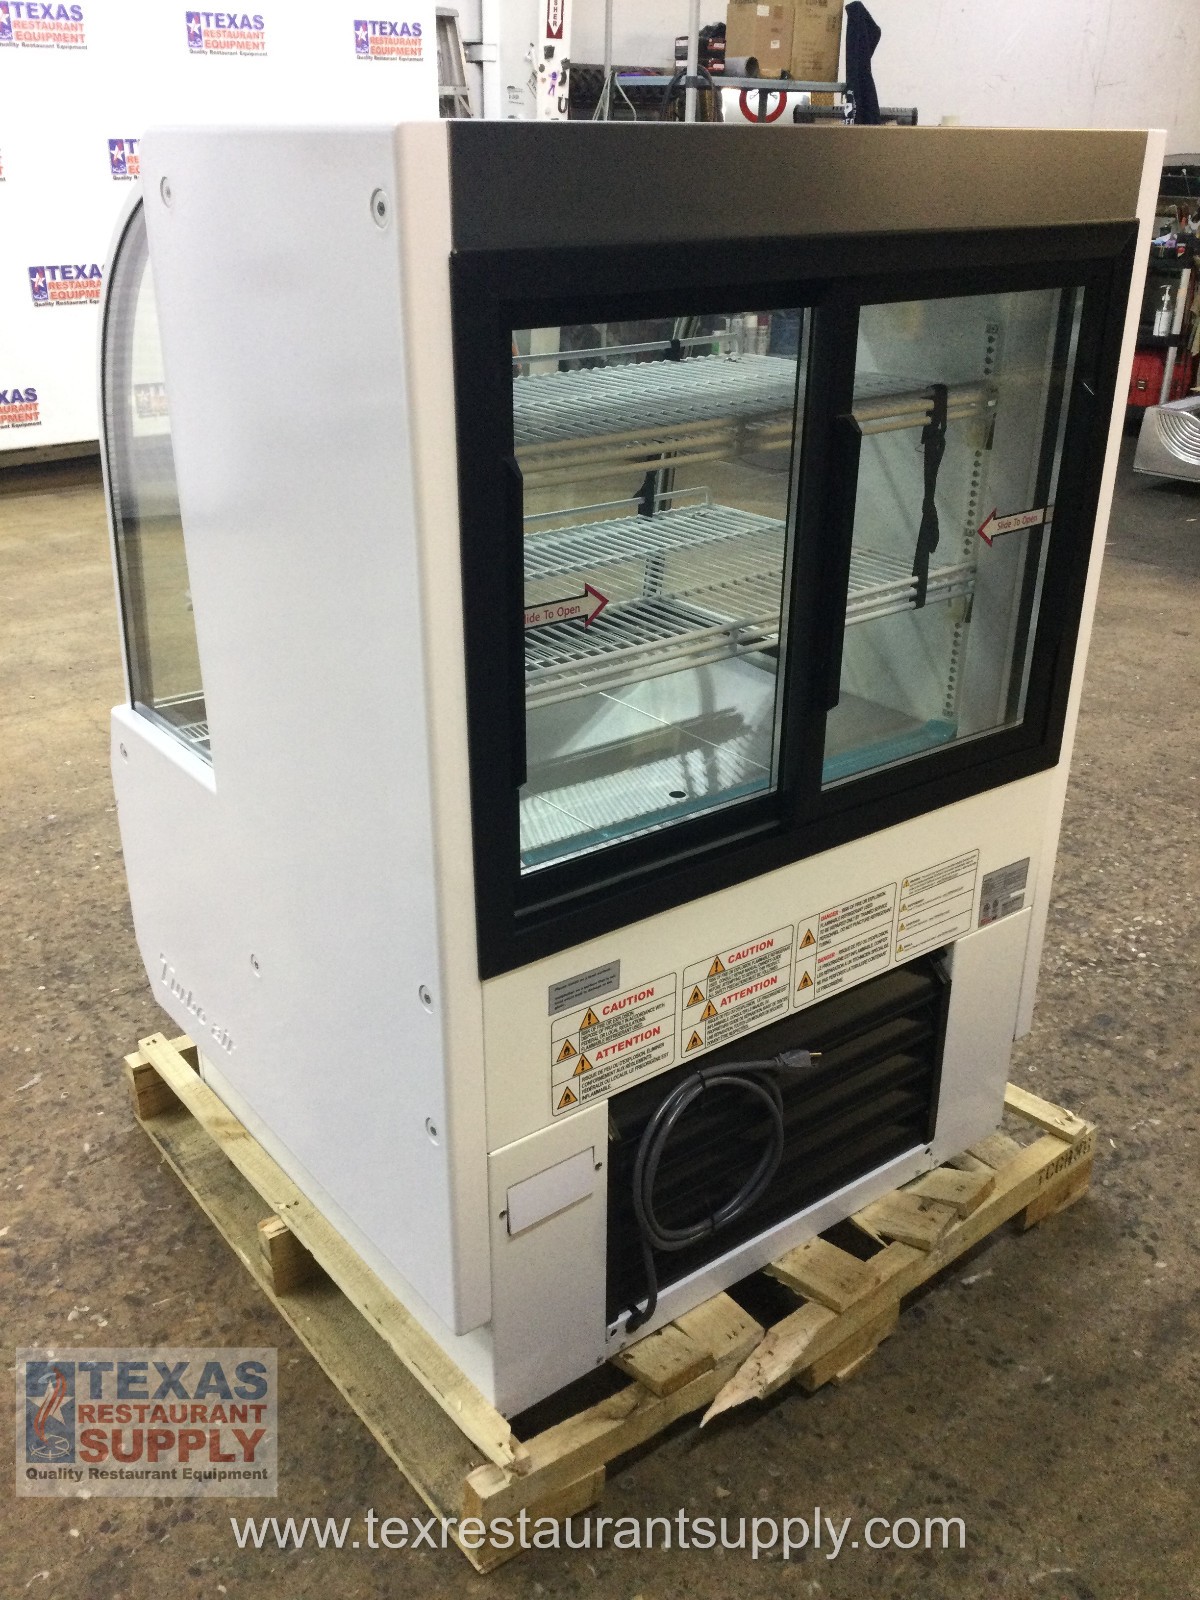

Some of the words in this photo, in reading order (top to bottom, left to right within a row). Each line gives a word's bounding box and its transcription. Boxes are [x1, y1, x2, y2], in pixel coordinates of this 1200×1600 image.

[10, 1, 83, 21] TEXAS
[13, 20, 84, 32] RESTAURANT
[202, 12, 264, 30] TEXAS
[369, 20, 422, 37] TEXAS
[15, 31, 85, 43] EQUIPMENT
[203, 29, 265, 39] RESTAURANT
[370, 36, 423, 46] RESTAURANT
[205, 40, 266, 50] EQUIPMENT
[371, 46, 423, 56] EQUIPMENT
[997, 520, 1012, 531] Slide
[1013, 518, 1020, 527] To
[1021, 515, 1038, 525] Open
[523, 613, 541, 624] lide
[544, 609, 554, 619] To
[556, 605, 581, 618] Open
[727, 939, 774, 964] CAUTION
[720, 976, 778, 1007] ATTENTION
[602, 987, 655, 1016] CAUTION
[595, 1025, 661, 1060] ATTENTION
